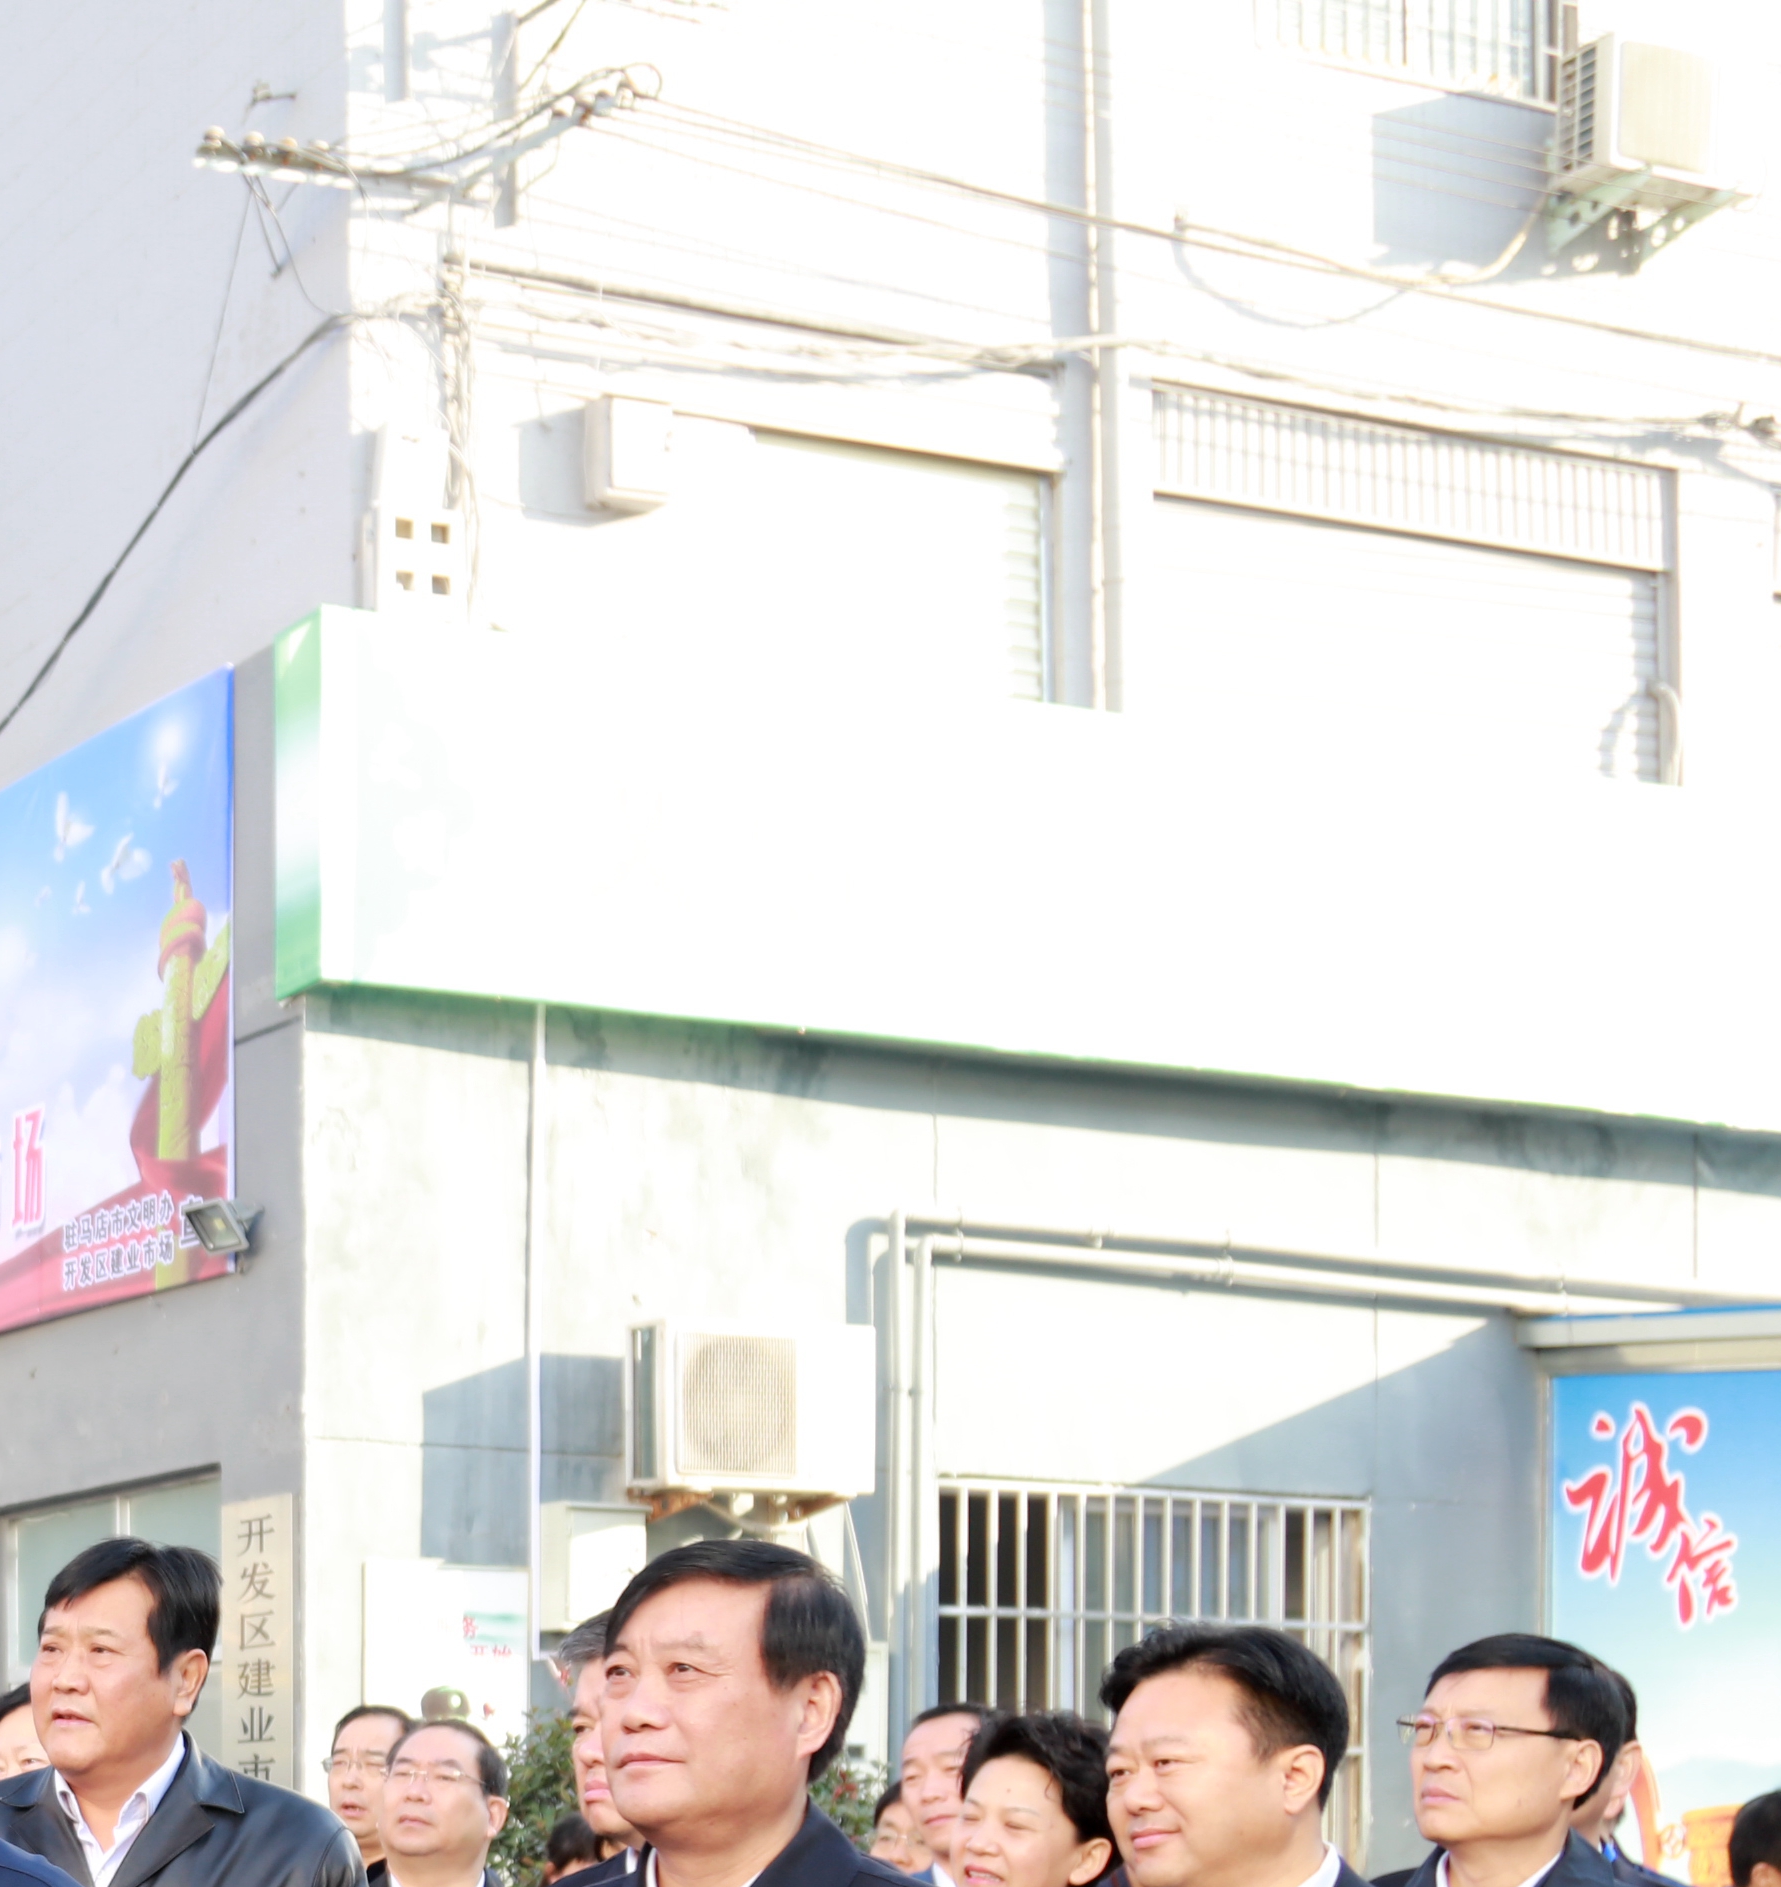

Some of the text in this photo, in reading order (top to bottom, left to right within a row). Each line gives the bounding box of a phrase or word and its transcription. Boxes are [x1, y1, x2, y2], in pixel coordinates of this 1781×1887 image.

[64, 1192, 174, 1251] 驻马店市文明办
[64, 1233, 174, 1290] 开发区建业市场
[1566, 1407, 1739, 1626] 诚信
